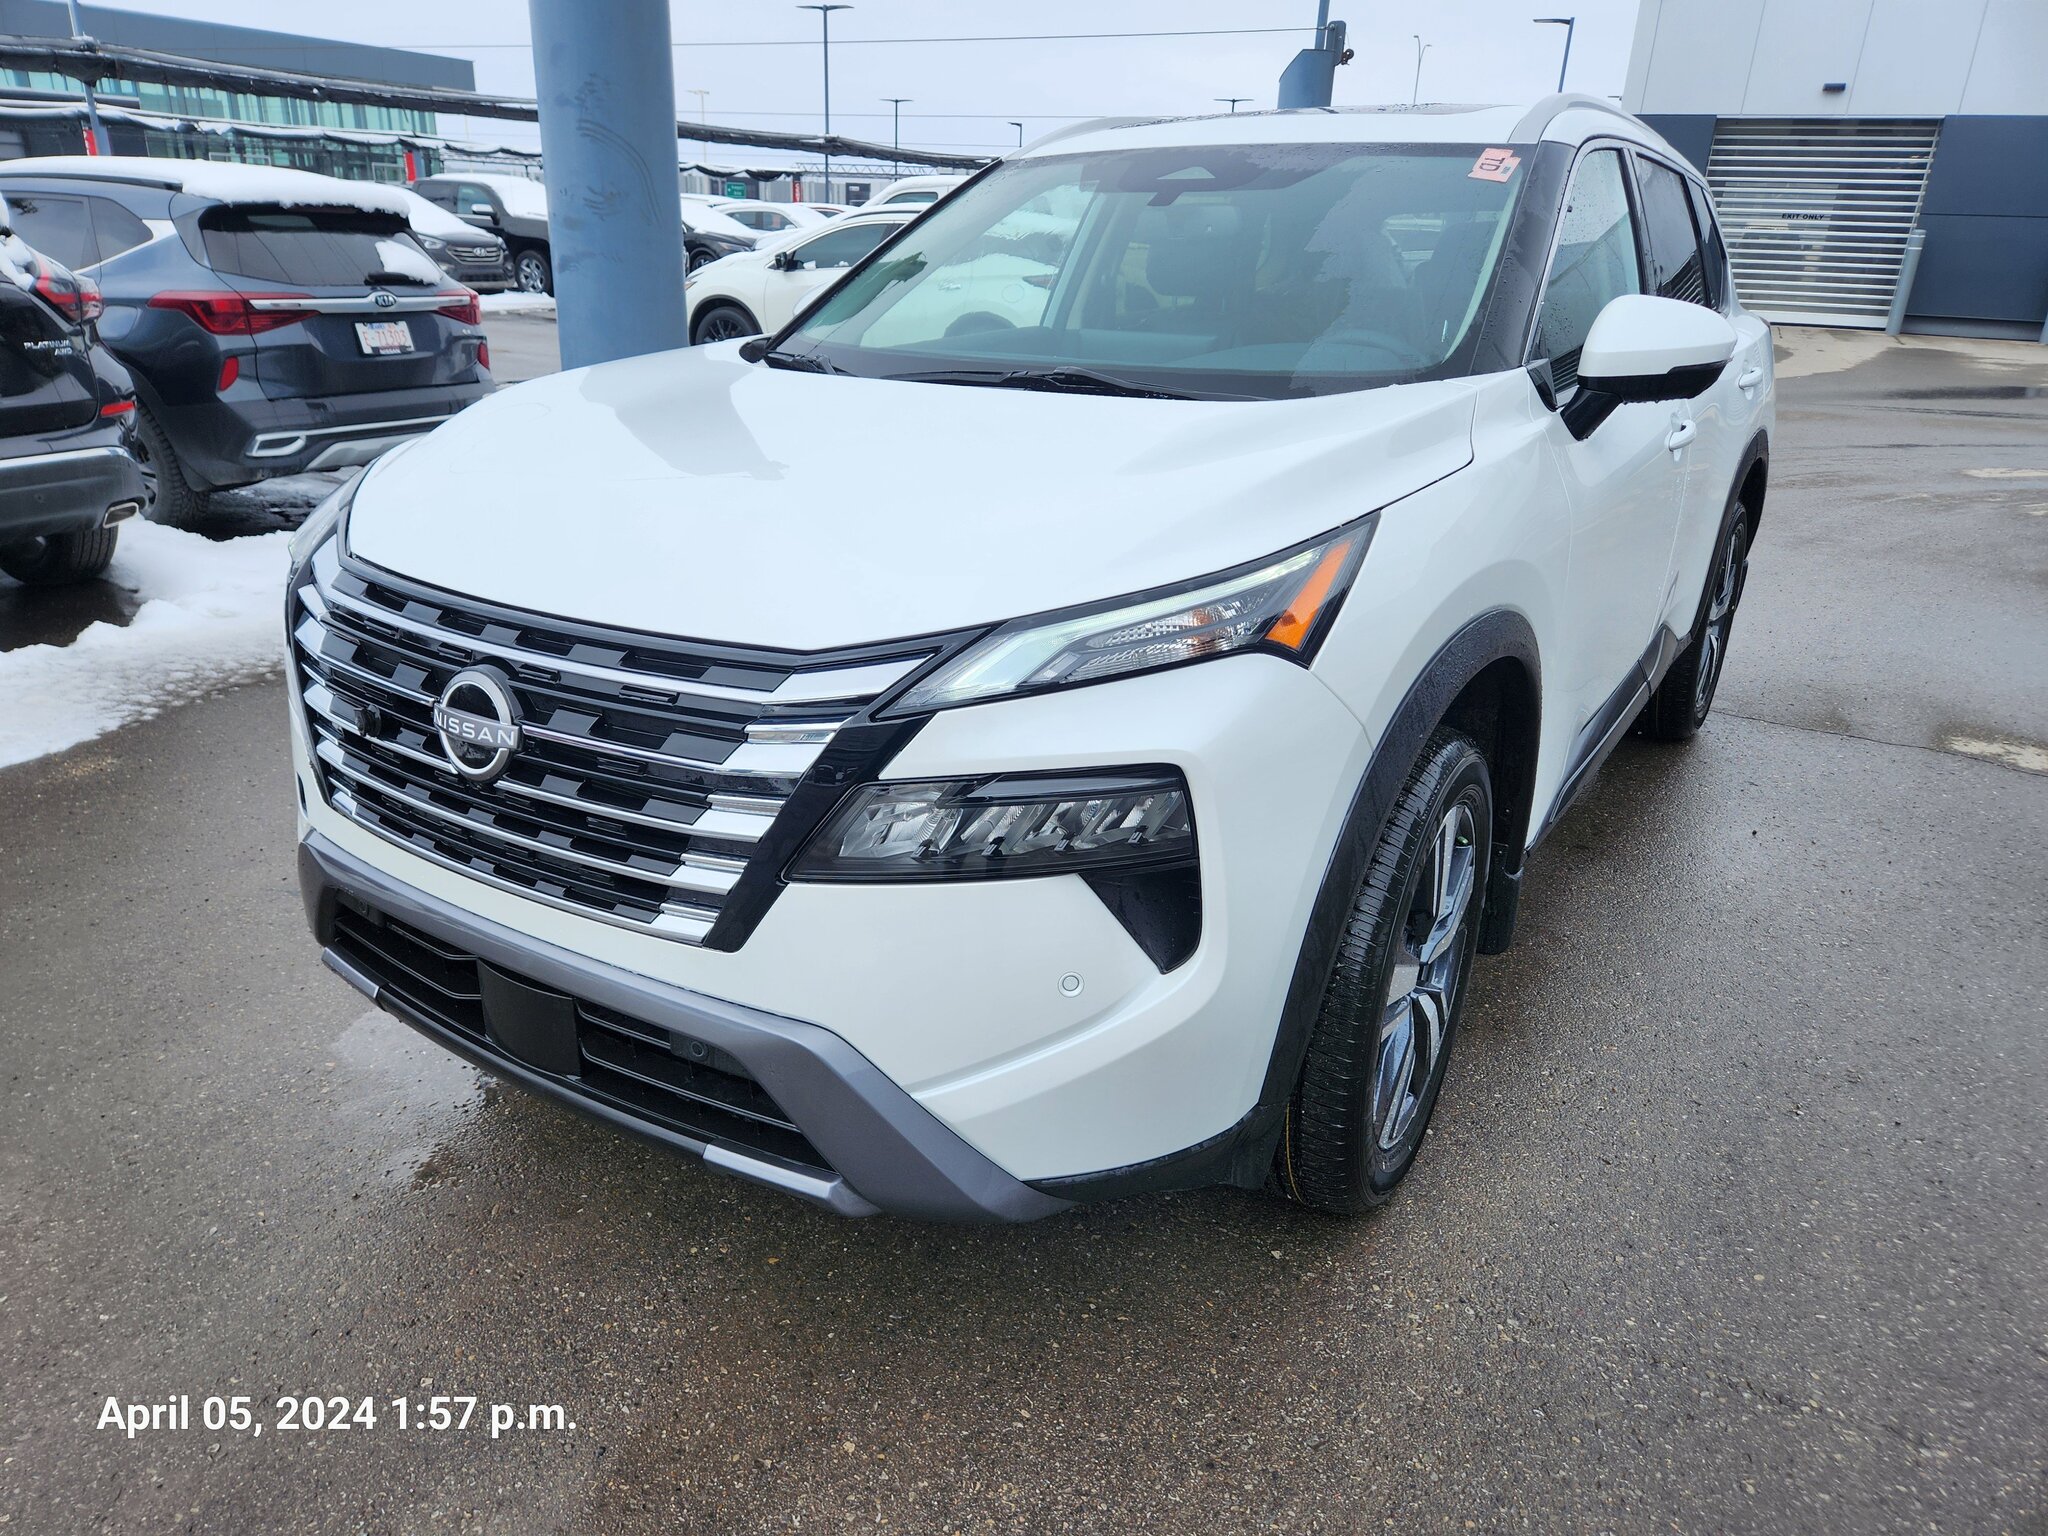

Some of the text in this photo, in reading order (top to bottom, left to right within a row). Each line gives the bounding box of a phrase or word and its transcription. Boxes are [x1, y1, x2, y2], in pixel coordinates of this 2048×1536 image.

[376, 295, 396, 306] KIA
[23, 340, 71, 350] PLATINUM
[54, 347, 73, 356] AWD
[433, 708, 515, 746] NISSAN
